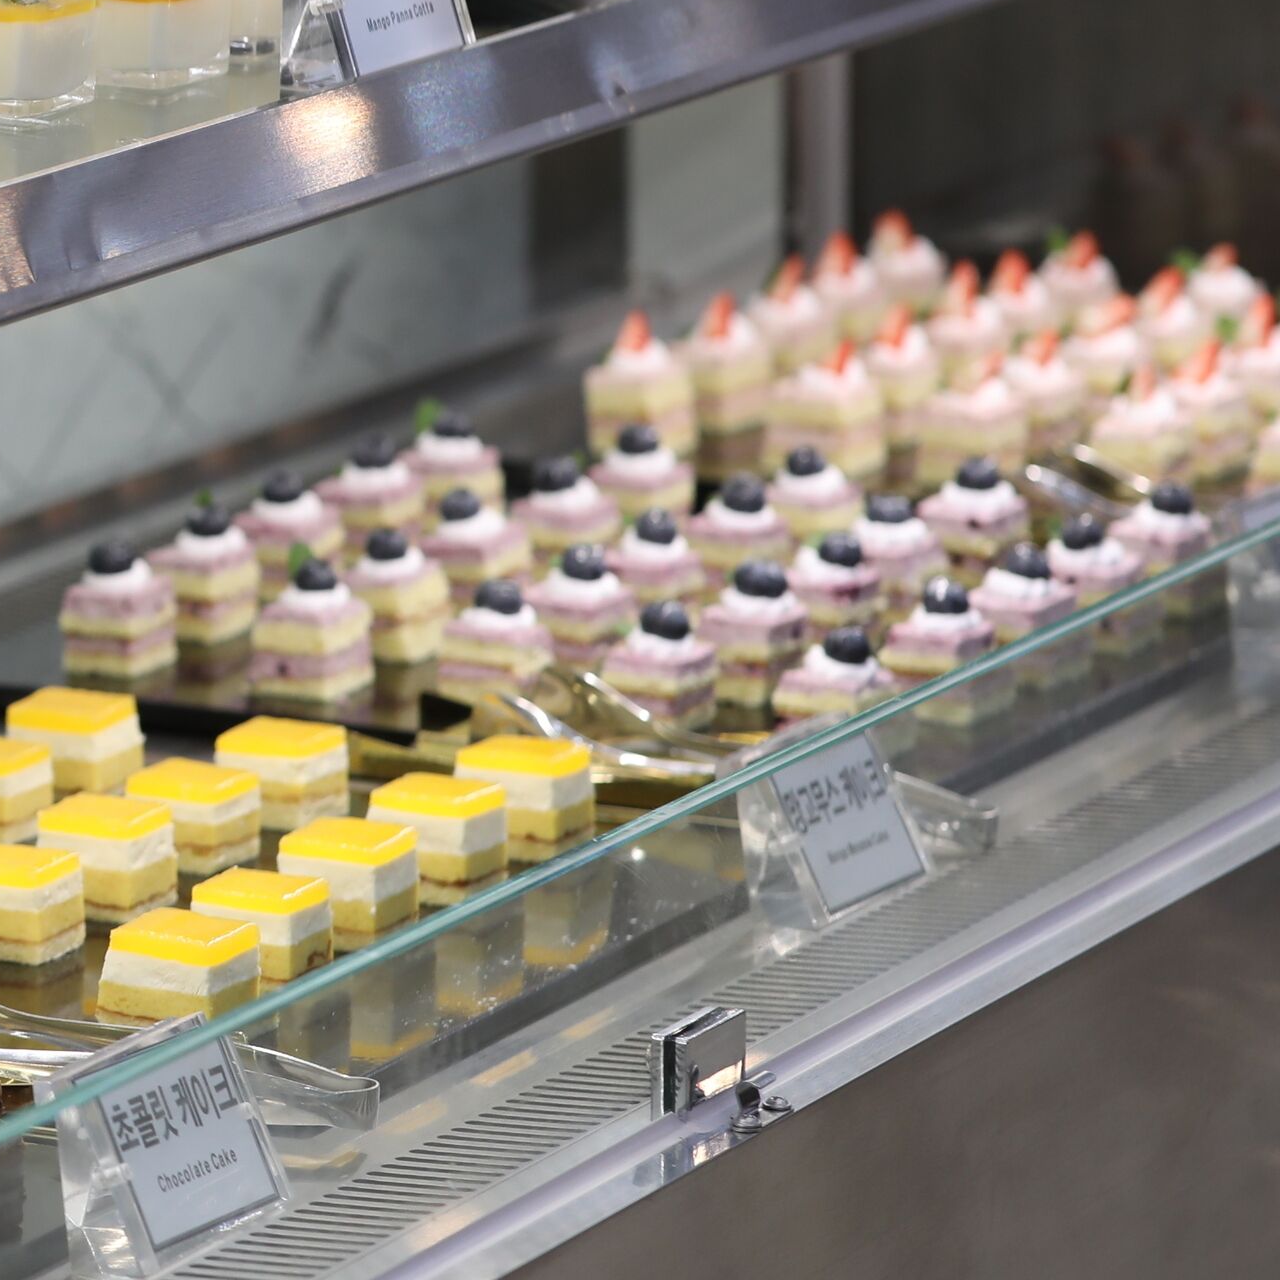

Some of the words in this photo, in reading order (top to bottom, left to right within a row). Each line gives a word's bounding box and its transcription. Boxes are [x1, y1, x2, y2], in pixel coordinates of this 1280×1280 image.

[366, 14, 390, 32] Mango
[390, 8, 413, 24] Panna
[413, 1, 434, 18] Cotta
[111, 1085, 179, 1152] 초콜릿
[170, 1065, 238, 1127] 케이크
[157, 1160, 211, 1193] Chocolate
[211, 1148, 238, 1174] Cake
